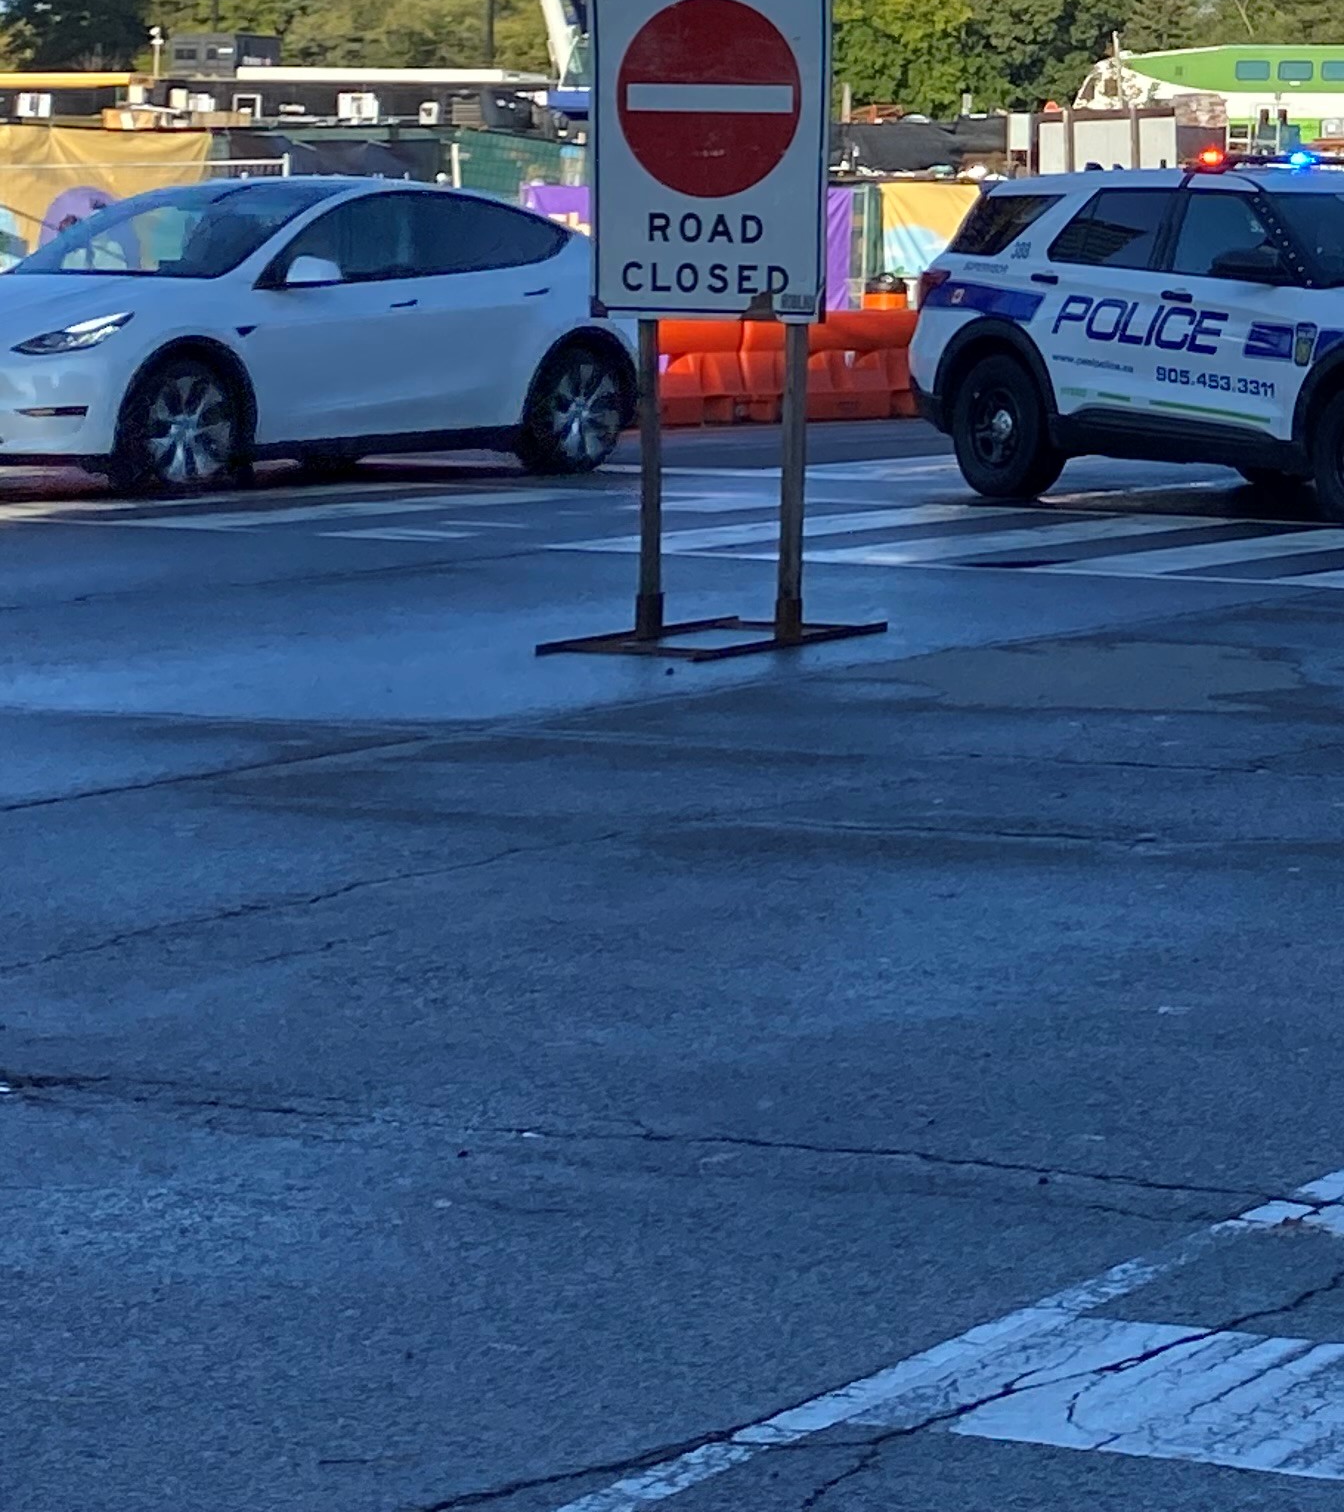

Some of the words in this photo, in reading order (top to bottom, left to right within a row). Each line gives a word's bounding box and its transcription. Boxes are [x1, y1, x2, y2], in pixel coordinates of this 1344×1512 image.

[648, 212, 763, 244] ROAD
[622, 262, 790, 295] CLOSED
[1051, 294, 1230, 356] POLICE
[1155, 365, 1276, 398] 905.453.3311
